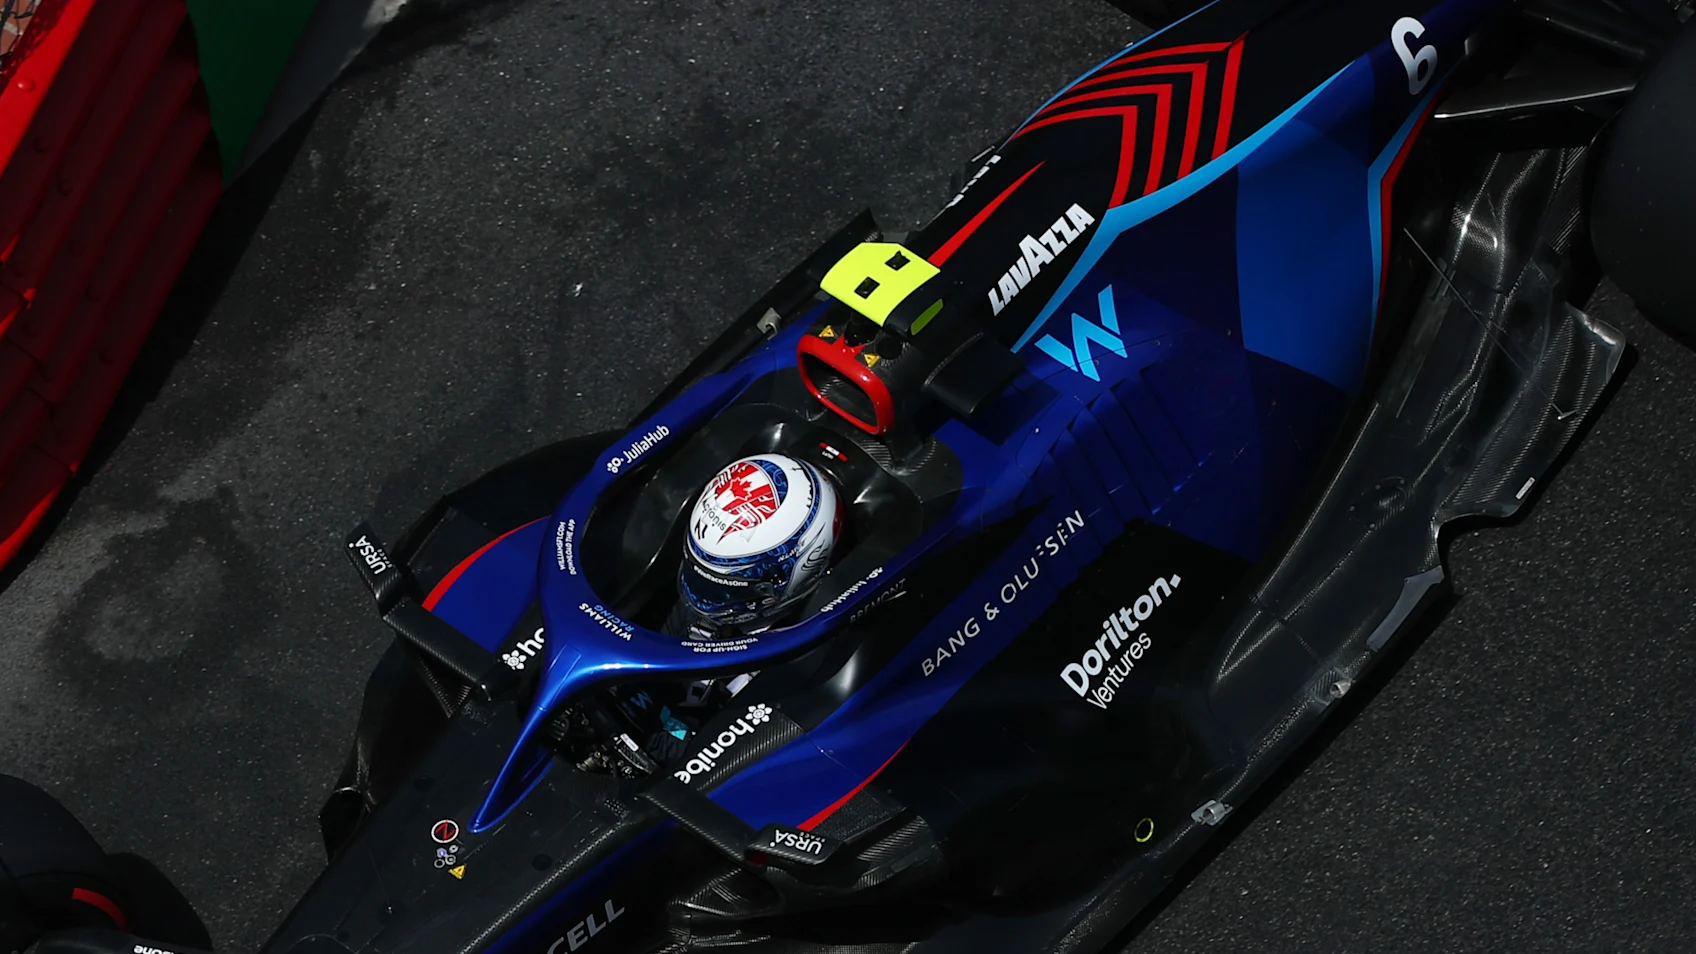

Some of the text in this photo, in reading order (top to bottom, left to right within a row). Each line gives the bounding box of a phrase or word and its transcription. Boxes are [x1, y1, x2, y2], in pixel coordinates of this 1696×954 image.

[1391, 17, 1438, 95] 6
[987, 203, 1096, 316] LAVAZZA
[1035, 284, 1128, 382] W
[623, 425, 670, 463] JuliaHub
[355, 535, 387, 575] URSA
[579, 602, 633, 641] WILLIAMS
[593, 604, 635, 632] RACING
[921, 617, 981, 677] BANG
[984, 601, 1000, 621] &
[1060, 573, 1182, 698] Dorilton.
[1087, 632, 1152, 710] Ventures
[674, 718, 755, 784] honibe
[775, 829, 823, 855] URSA
